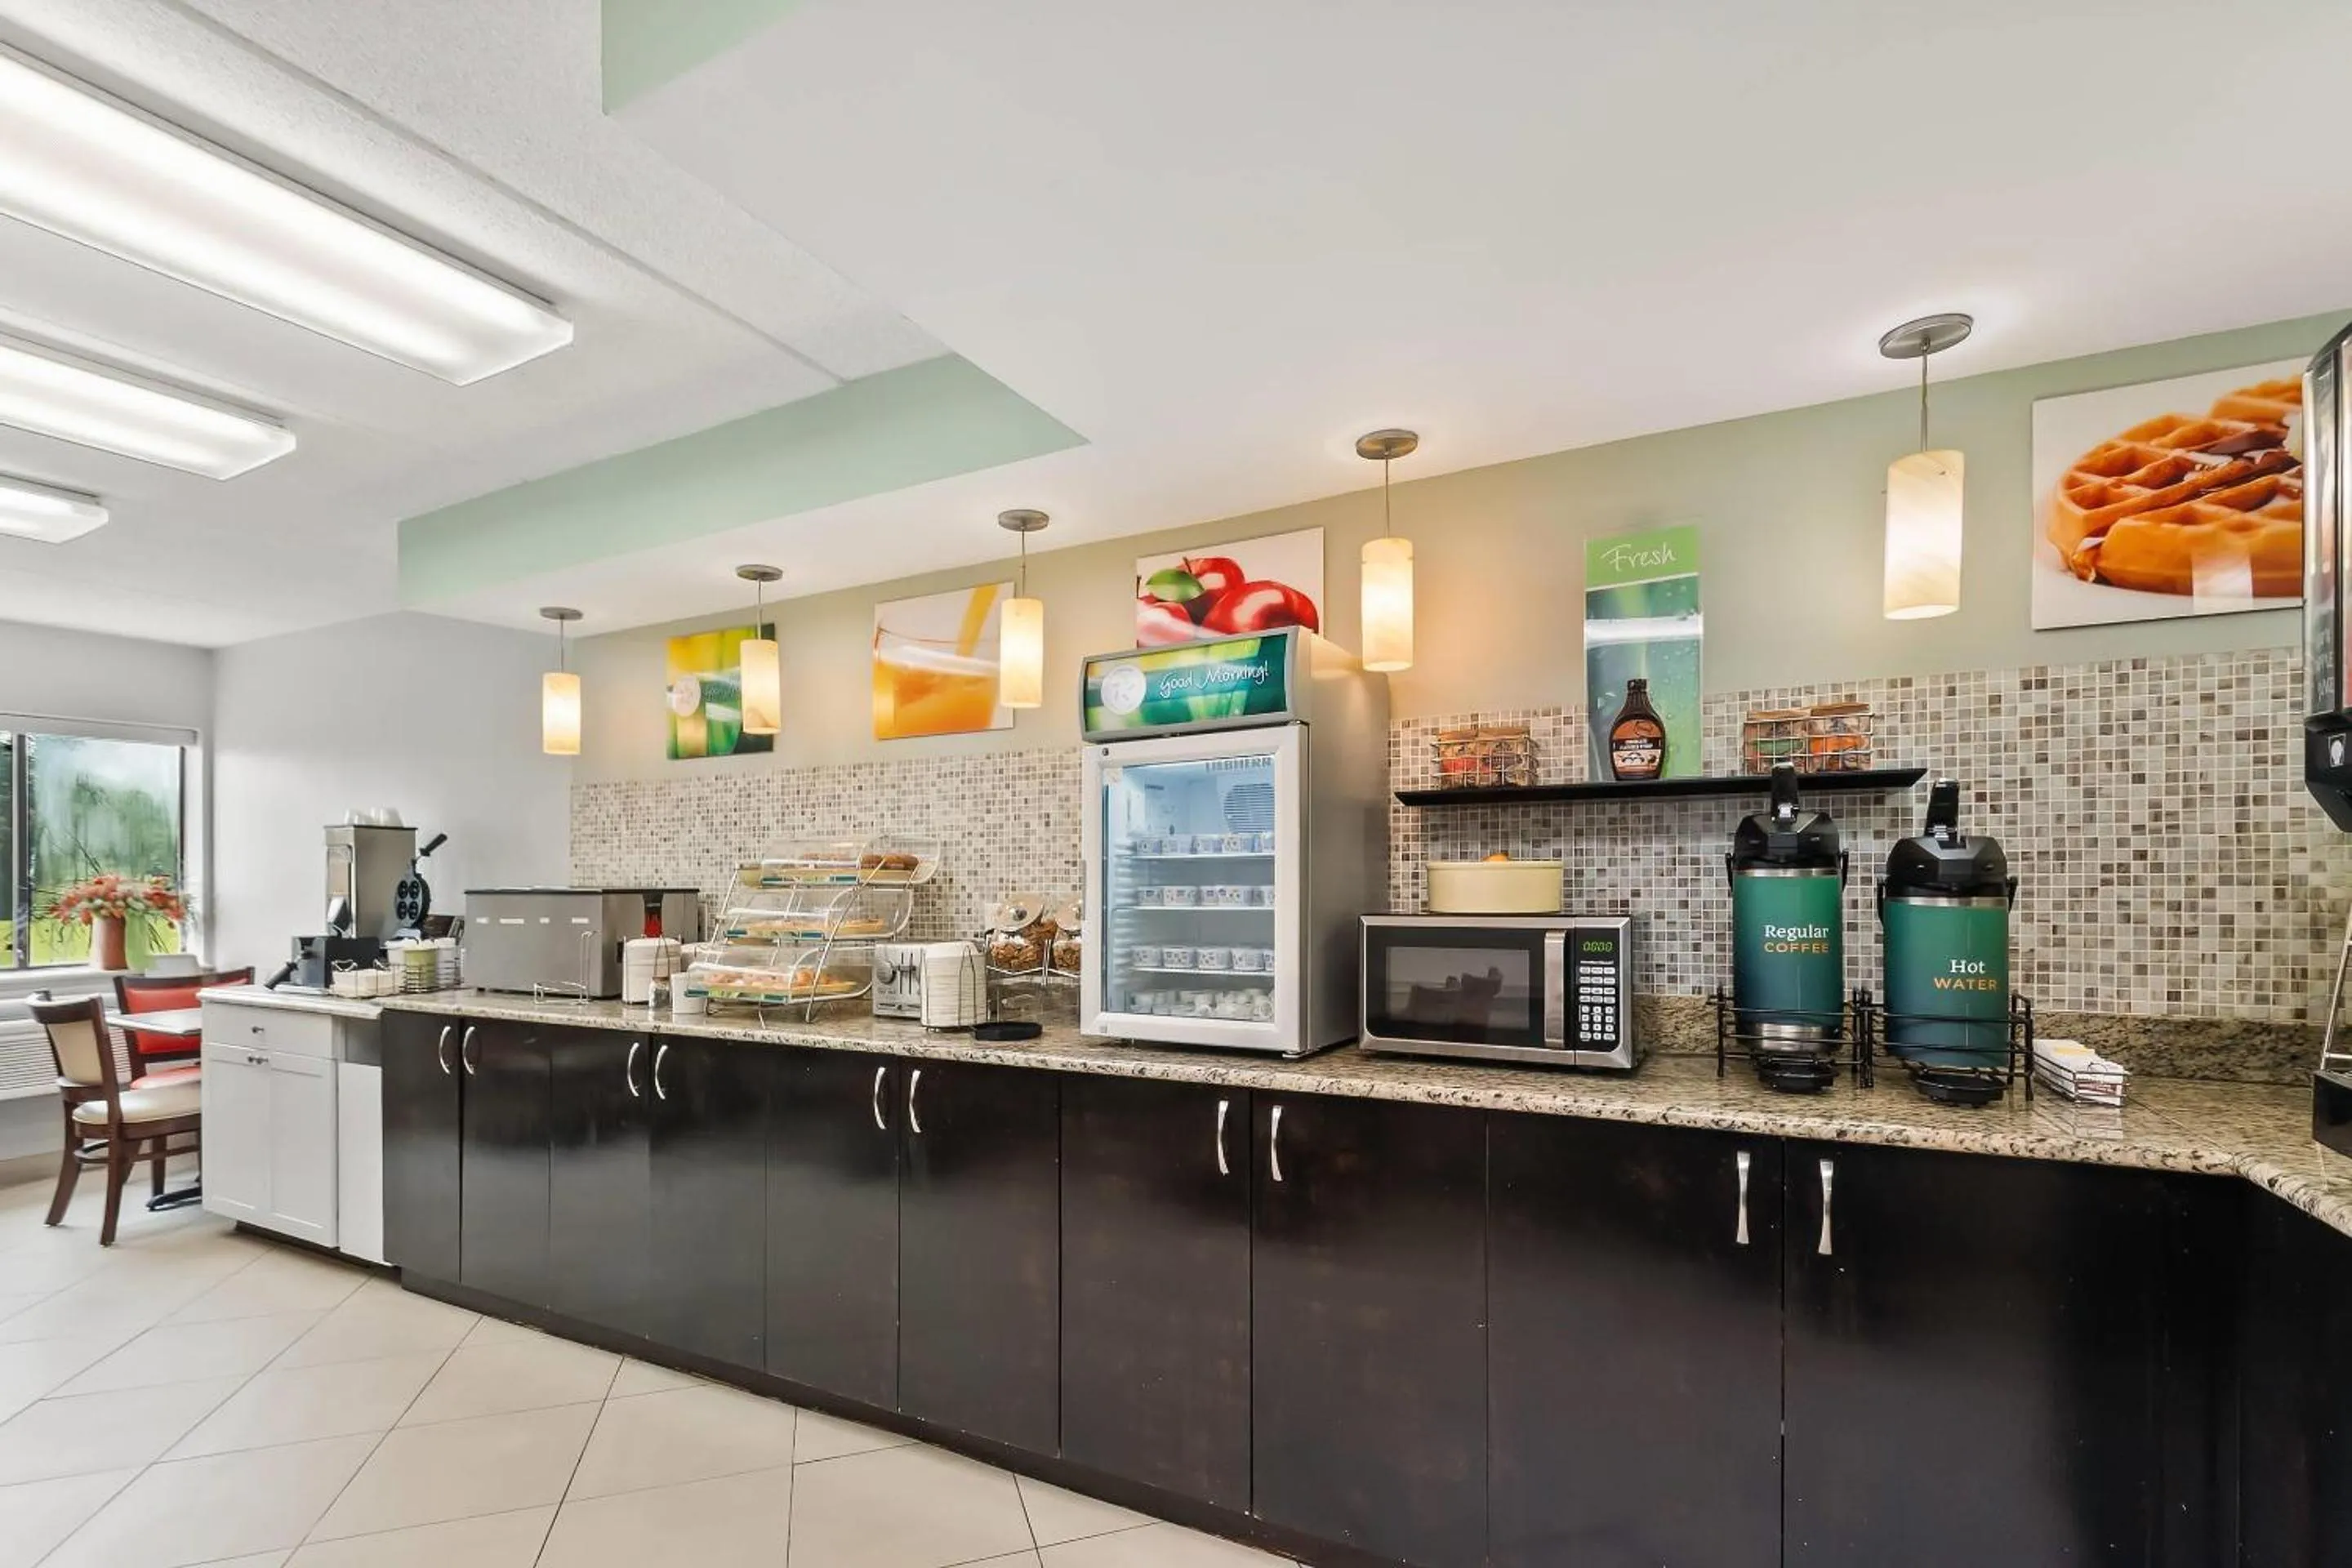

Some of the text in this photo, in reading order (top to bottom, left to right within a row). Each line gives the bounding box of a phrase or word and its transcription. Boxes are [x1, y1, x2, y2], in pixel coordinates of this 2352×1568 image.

[1600, 541, 1677, 572] Fresh
[1160, 660, 1269, 698] Good Morning!
[1763, 924, 1829, 942] Regular
[1764, 942, 1829, 953] COFFEE
[1949, 959, 1986, 974] Hot
[1933, 978, 1998, 991] WATER
